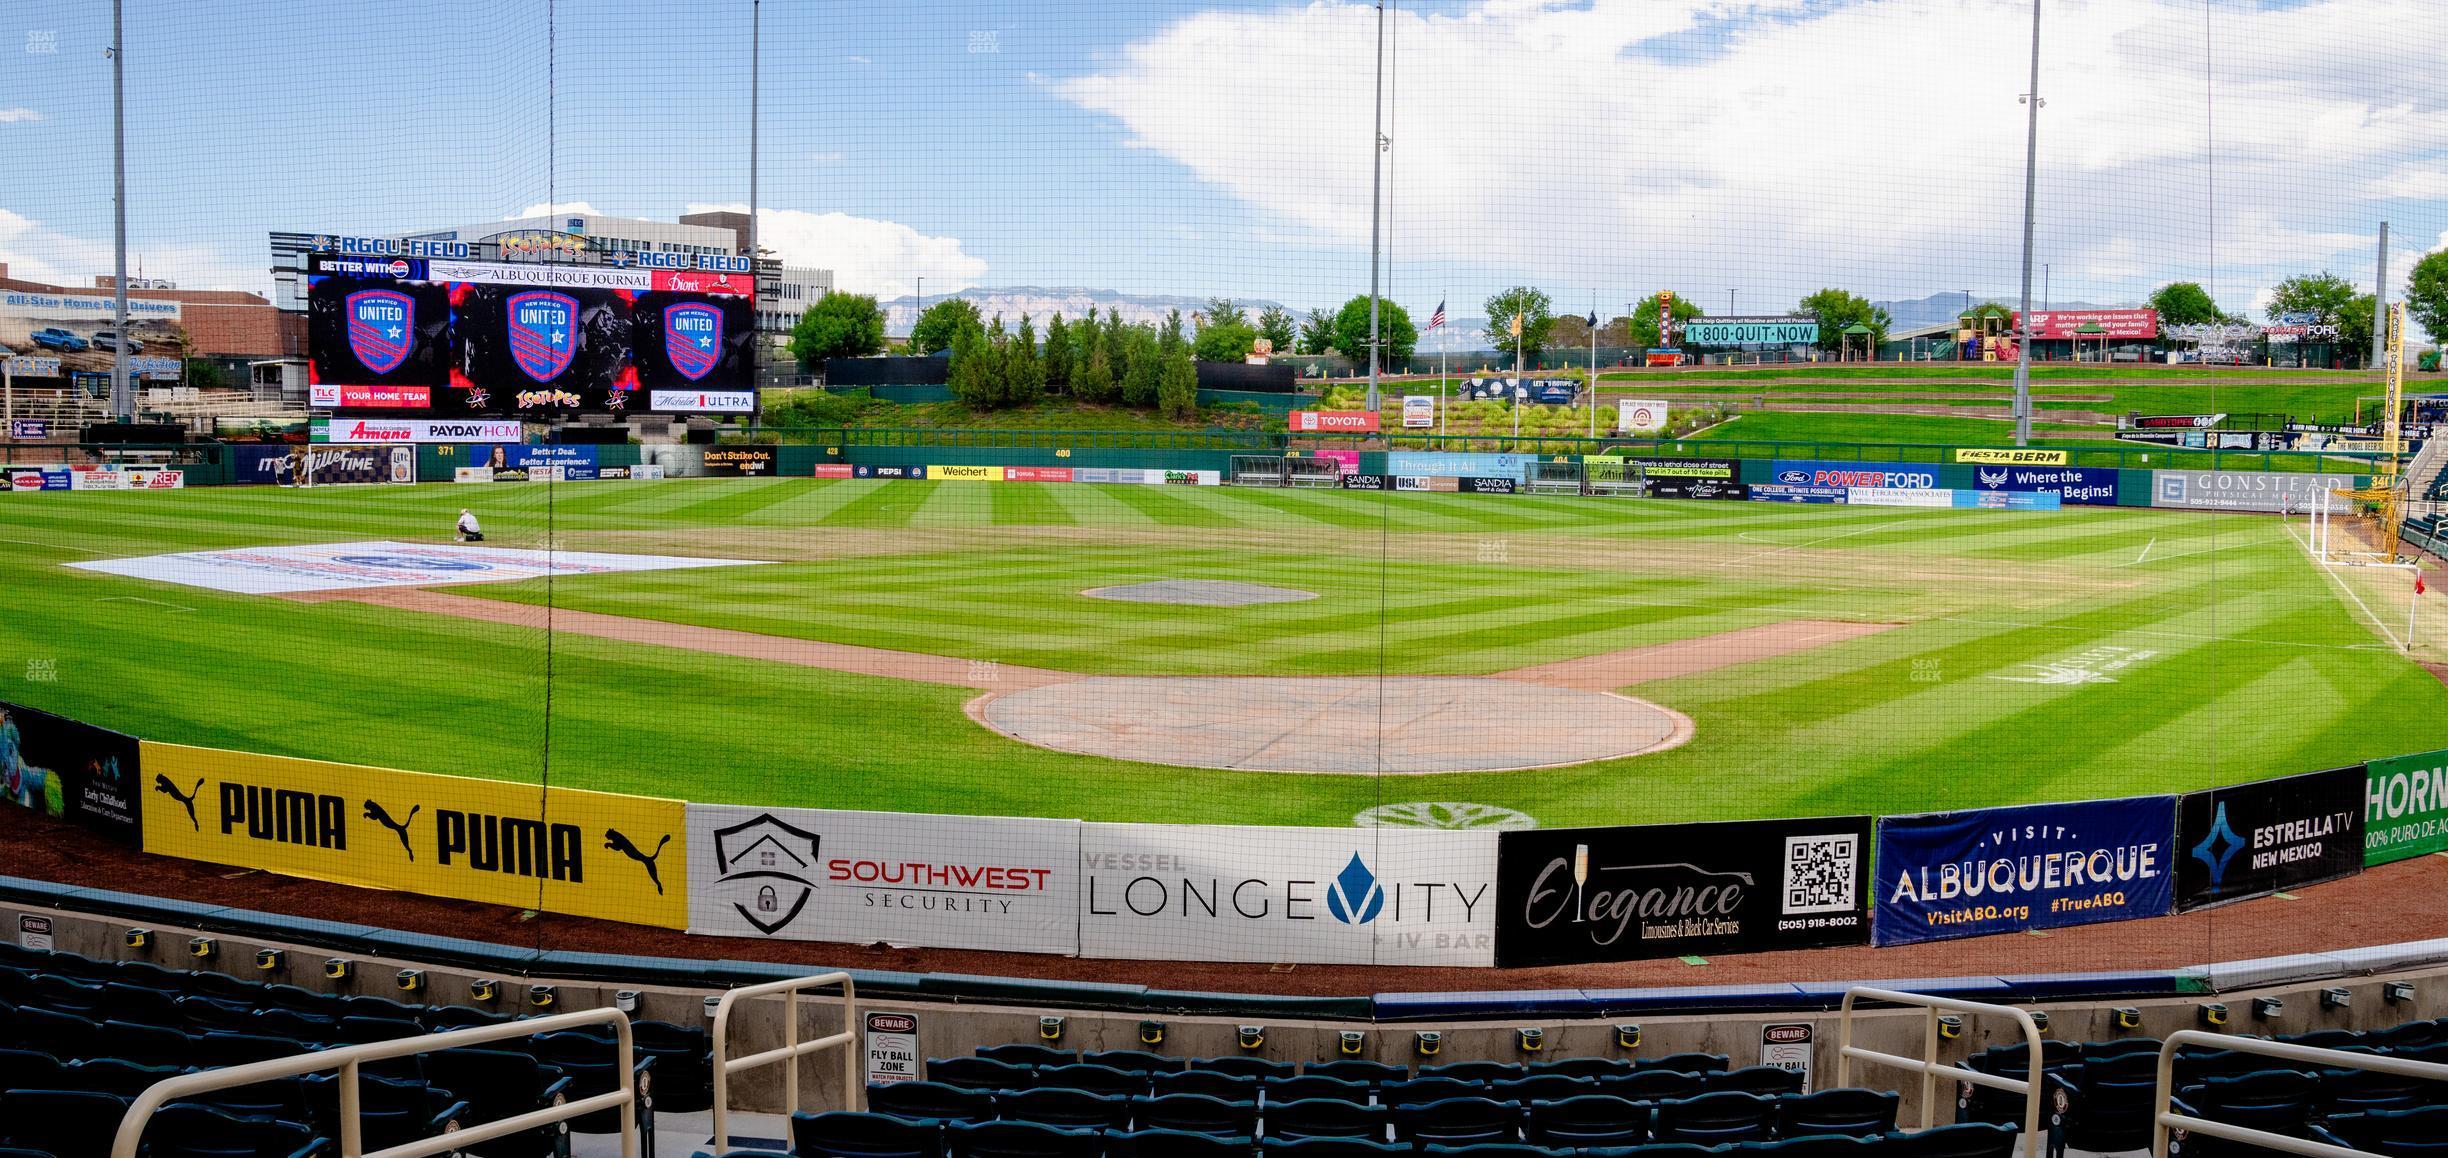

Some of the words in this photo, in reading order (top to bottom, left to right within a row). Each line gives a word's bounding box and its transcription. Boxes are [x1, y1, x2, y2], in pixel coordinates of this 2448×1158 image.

[341, 236, 401, 254] RGCU
[408, 239, 469, 258] FIELD
[320, 261, 363, 272] BETTER
[365, 262, 392, 273] WITH
[637, 250, 690, 268] RGCU
[697, 254, 749, 272] FIELD
[491, 270, 589, 284] ALBUQUERQUE
[592, 274, 649, 286] JOURNAL
[668, 273, 699, 291] Dion's
[7, 295, 60, 307] All-Star
[64, 298, 100, 310] Home
[130, 302, 177, 313] Drivers
[360, 306, 402, 321] UNITED
[521, 309, 565, 325] UNITED
[676, 319, 712, 331] UNITED
[2128, 321, 2148, 329] family
[2262, 326, 2306, 335] POWER
[2307, 325, 2339, 335] FORD
[315, 389, 335, 397] TLC
[374, 392, 400, 400] HOME
[655, 396, 696, 406] Michelob
[708, 397, 749, 406] ULTRA
[1321, 416, 1366, 426] TOYOTA
[350, 421, 411, 439] Amana
[430, 426, 482, 436] PAYDAY
[485, 426, 518, 436] HCM
[438, 447, 454, 456] 371
[2338, 442, 2346, 450] THE
[704, 452, 727, 460] Don't
[728, 452, 752, 460] Strike
[753, 452, 770, 460] Out.
[1056, 450, 1071, 458] 400
[2012, 452, 2060, 462] BERM
[340, 458, 374, 470] TIME
[519, 458, 544, 466] Better
[740, 460, 764, 470] endwi
[1400, 460, 1446, 473] Through
[1450, 461, 1456, 471] It
[1460, 462, 1476, 472] All
[1634, 460, 1658, 468] There's
[84, 472, 118, 480] ESPN
[600, 468, 630, 477] ESPN+
[942, 466, 988, 476] Weichert
[1165, 470, 1186, 480] Clark's
[1186, 471, 1198, 480] Pet
[1784, 472, 1805, 482] Ford
[154, 472, 178, 484] RED
[1346, 476, 1381, 484] SANDIA
[1474, 478, 1512, 488] SANDIA
[1814, 470, 1884, 487] POWER
[1884, 472, 1933, 488] FORD
[2016, 472, 2058, 484] Where
[2060, 471, 2082, 482] the
[2198, 474, 2341, 492] GONSTEAD
[2064, 485, 2112, 500] Begins!
[2206, 490, 2264, 498] PHYSICAL
[84, 788, 98, 803] Early
[100, 791, 127, 810] Childhood
[219, 781, 347, 851] PUMA
[2254, 815, 2333, 849] ESTRELLA
[2334, 811, 2354, 833] TV
[2390, 821, 2420, 844] PURO
[2422, 818, 2436, 837] DE
[436, 809, 583, 884] PUMA
[1085, 852, 1187, 872] VESSEL
[2252, 848, 2278, 870] NEW
[2279, 842, 2322, 865] MEXICO
[828, 859, 1052, 892] SOUTHWEST
[865, 893, 1013, 914] SECURITY
[1927, 905, 2030, 926] VisitABQ.org
[2051, 891, 2126, 913] #TrueABQ
[24, 920, 48, 930] BEWARE
[1641, 919, 1677, 940] Limousines
[1678, 923, 1684, 937] &
[1684, 920, 1702, 937] Black
[1703, 920, 1714, 935] Car
[1714, 918, 1740, 935] Services
[1778, 919, 1806, 931] (505)
[1806, 916, 1858, 930] 918-8002
[1397, 932, 1422, 949] IV
[1434, 934, 1491, 950] BAR
[874, 1019, 910, 1029] BEWARE
[1770, 1030, 1804, 1039] BEWARE
[871, 1050, 888, 1060] FLY
[890, 1051, 913, 1061] BALL
[880, 1062, 904, 1072] ZONE
[1785, 1062, 1807, 1070] BALL
